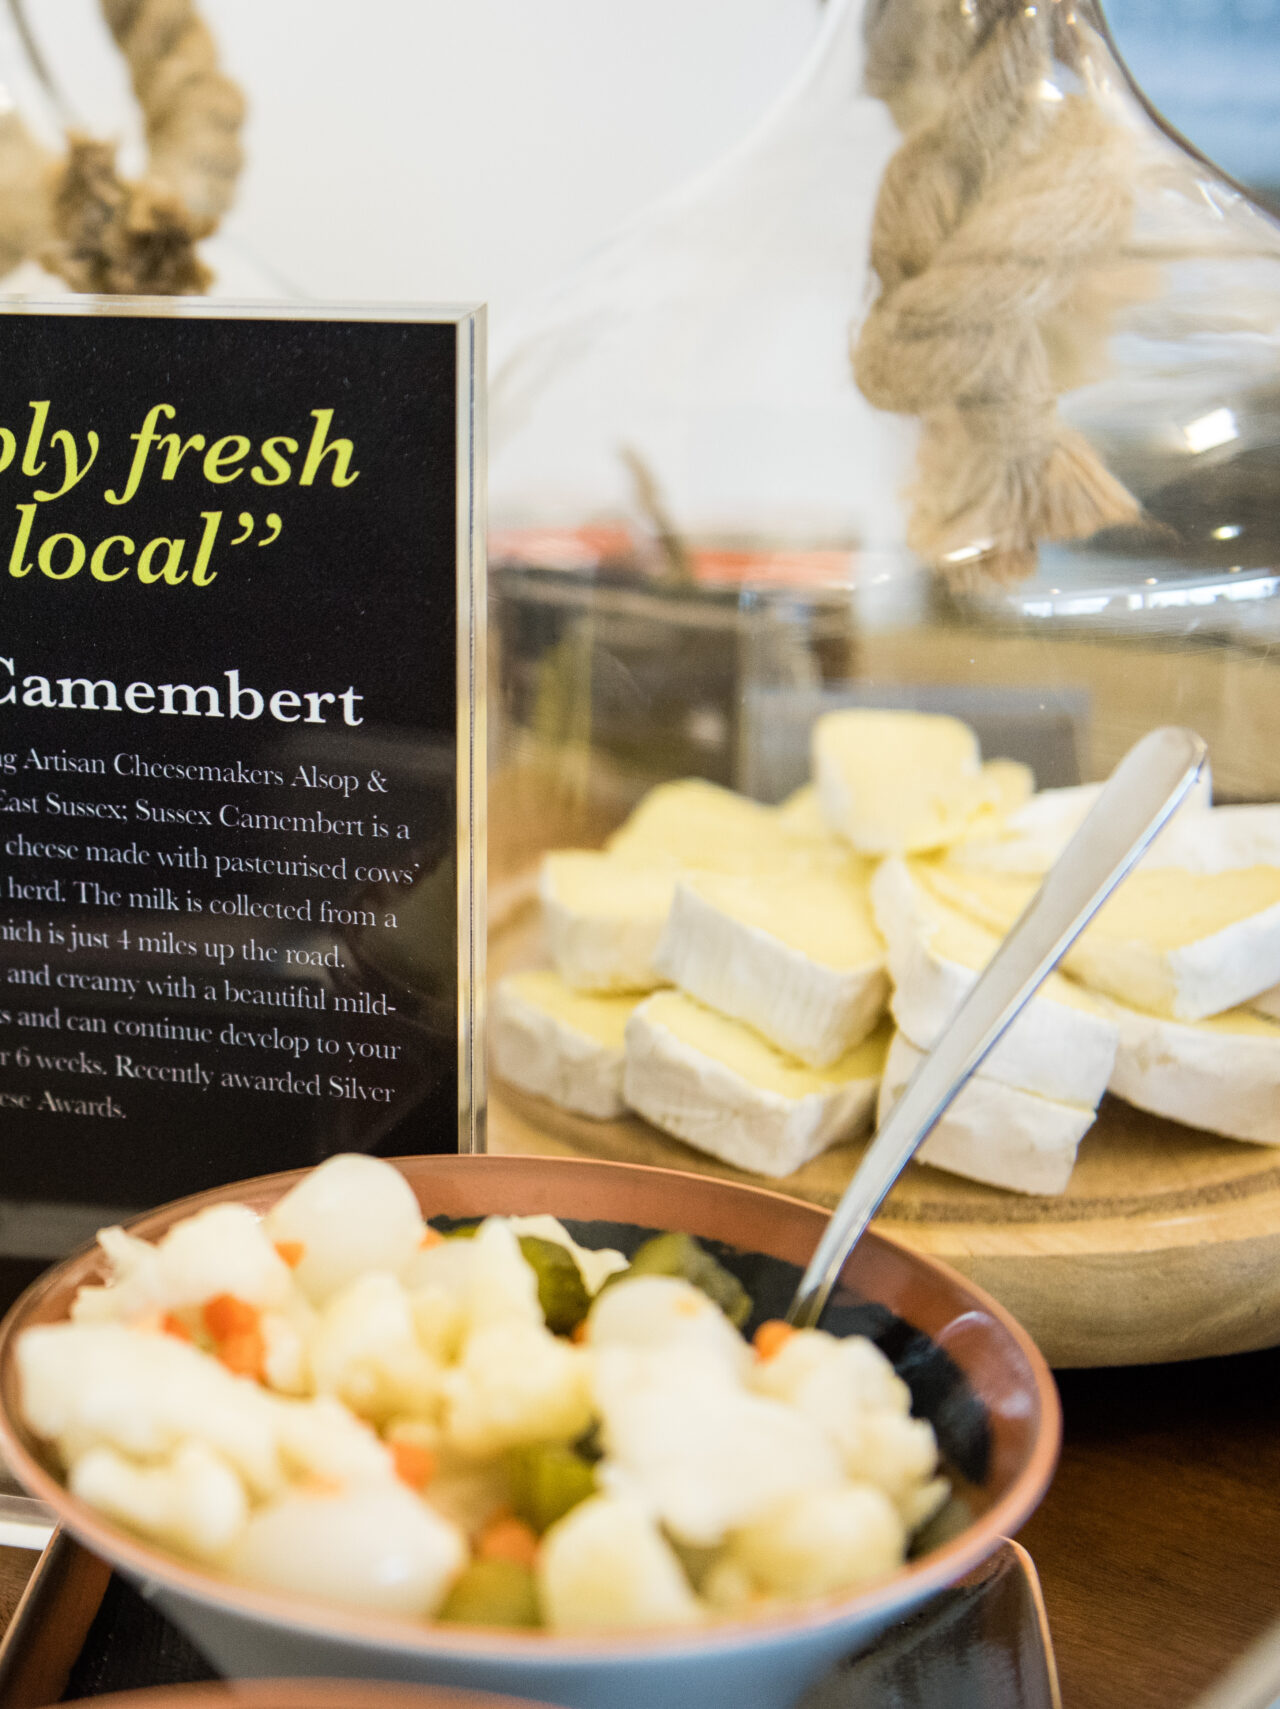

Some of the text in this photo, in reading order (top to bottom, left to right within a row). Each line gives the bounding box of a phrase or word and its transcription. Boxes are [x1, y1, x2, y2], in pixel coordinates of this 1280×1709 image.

[104, 403, 360, 505] fresh
[23, 748, 105, 774] Artisan
[114, 753, 284, 786] Cheesemakers
[290, 765, 359, 798] Alsop
[367, 770, 389, 793] &
[46, 792, 127, 821] Sussex;
[136, 799, 212, 825] Sussex
[219, 805, 364, 836] Camembert
[372, 814, 389, 838] is
[396, 823, 410, 840] a
[6, 834, 79, 860] cheese
[86, 842, 150, 866] made
[157, 846, 207, 869] with
[215, 855, 347, 880] pasteurised
[8, 876, 66, 902] herd.
[73, 880, 121, 907] The
[129, 887, 179, 911] milk
[187, 891, 203, 912] is
[210, 894, 312, 922] collected
[319, 900, 376, 926] from
[384, 912, 398, 928] a
[48, 922, 65, 944] is
[68, 924, 110, 952] just
[117, 928, 132, 950] 4
[138, 932, 197, 956] miles
[204, 941, 235, 965] up
[242, 937, 278, 962] the
[285, 942, 345, 968] road.
[8, 963, 50, 987] and
[56, 972, 140, 1000] creamy
[147, 975, 196, 999] with
[204, 984, 217, 1001] a
[225, 980, 326, 1010] beautiful
[334, 992, 396, 1016] mild-
[18, 1004, 60, 1029] and
[67, 1016, 107, 1033] can
[114, 1018, 213, 1043] continue
[220, 1023, 309, 1056] develop
[317, 1036, 339, 1054] to
[346, 1041, 401, 1063] your
[16, 1047, 31, 1068] 6
[38, 1051, 107, 1075] weeks.
[115, 1055, 214, 1091] Recently
[221, 1070, 321, 1096] awarded
[329, 1075, 395, 1102] Silver
[37, 1091, 126, 1119] Awards.
